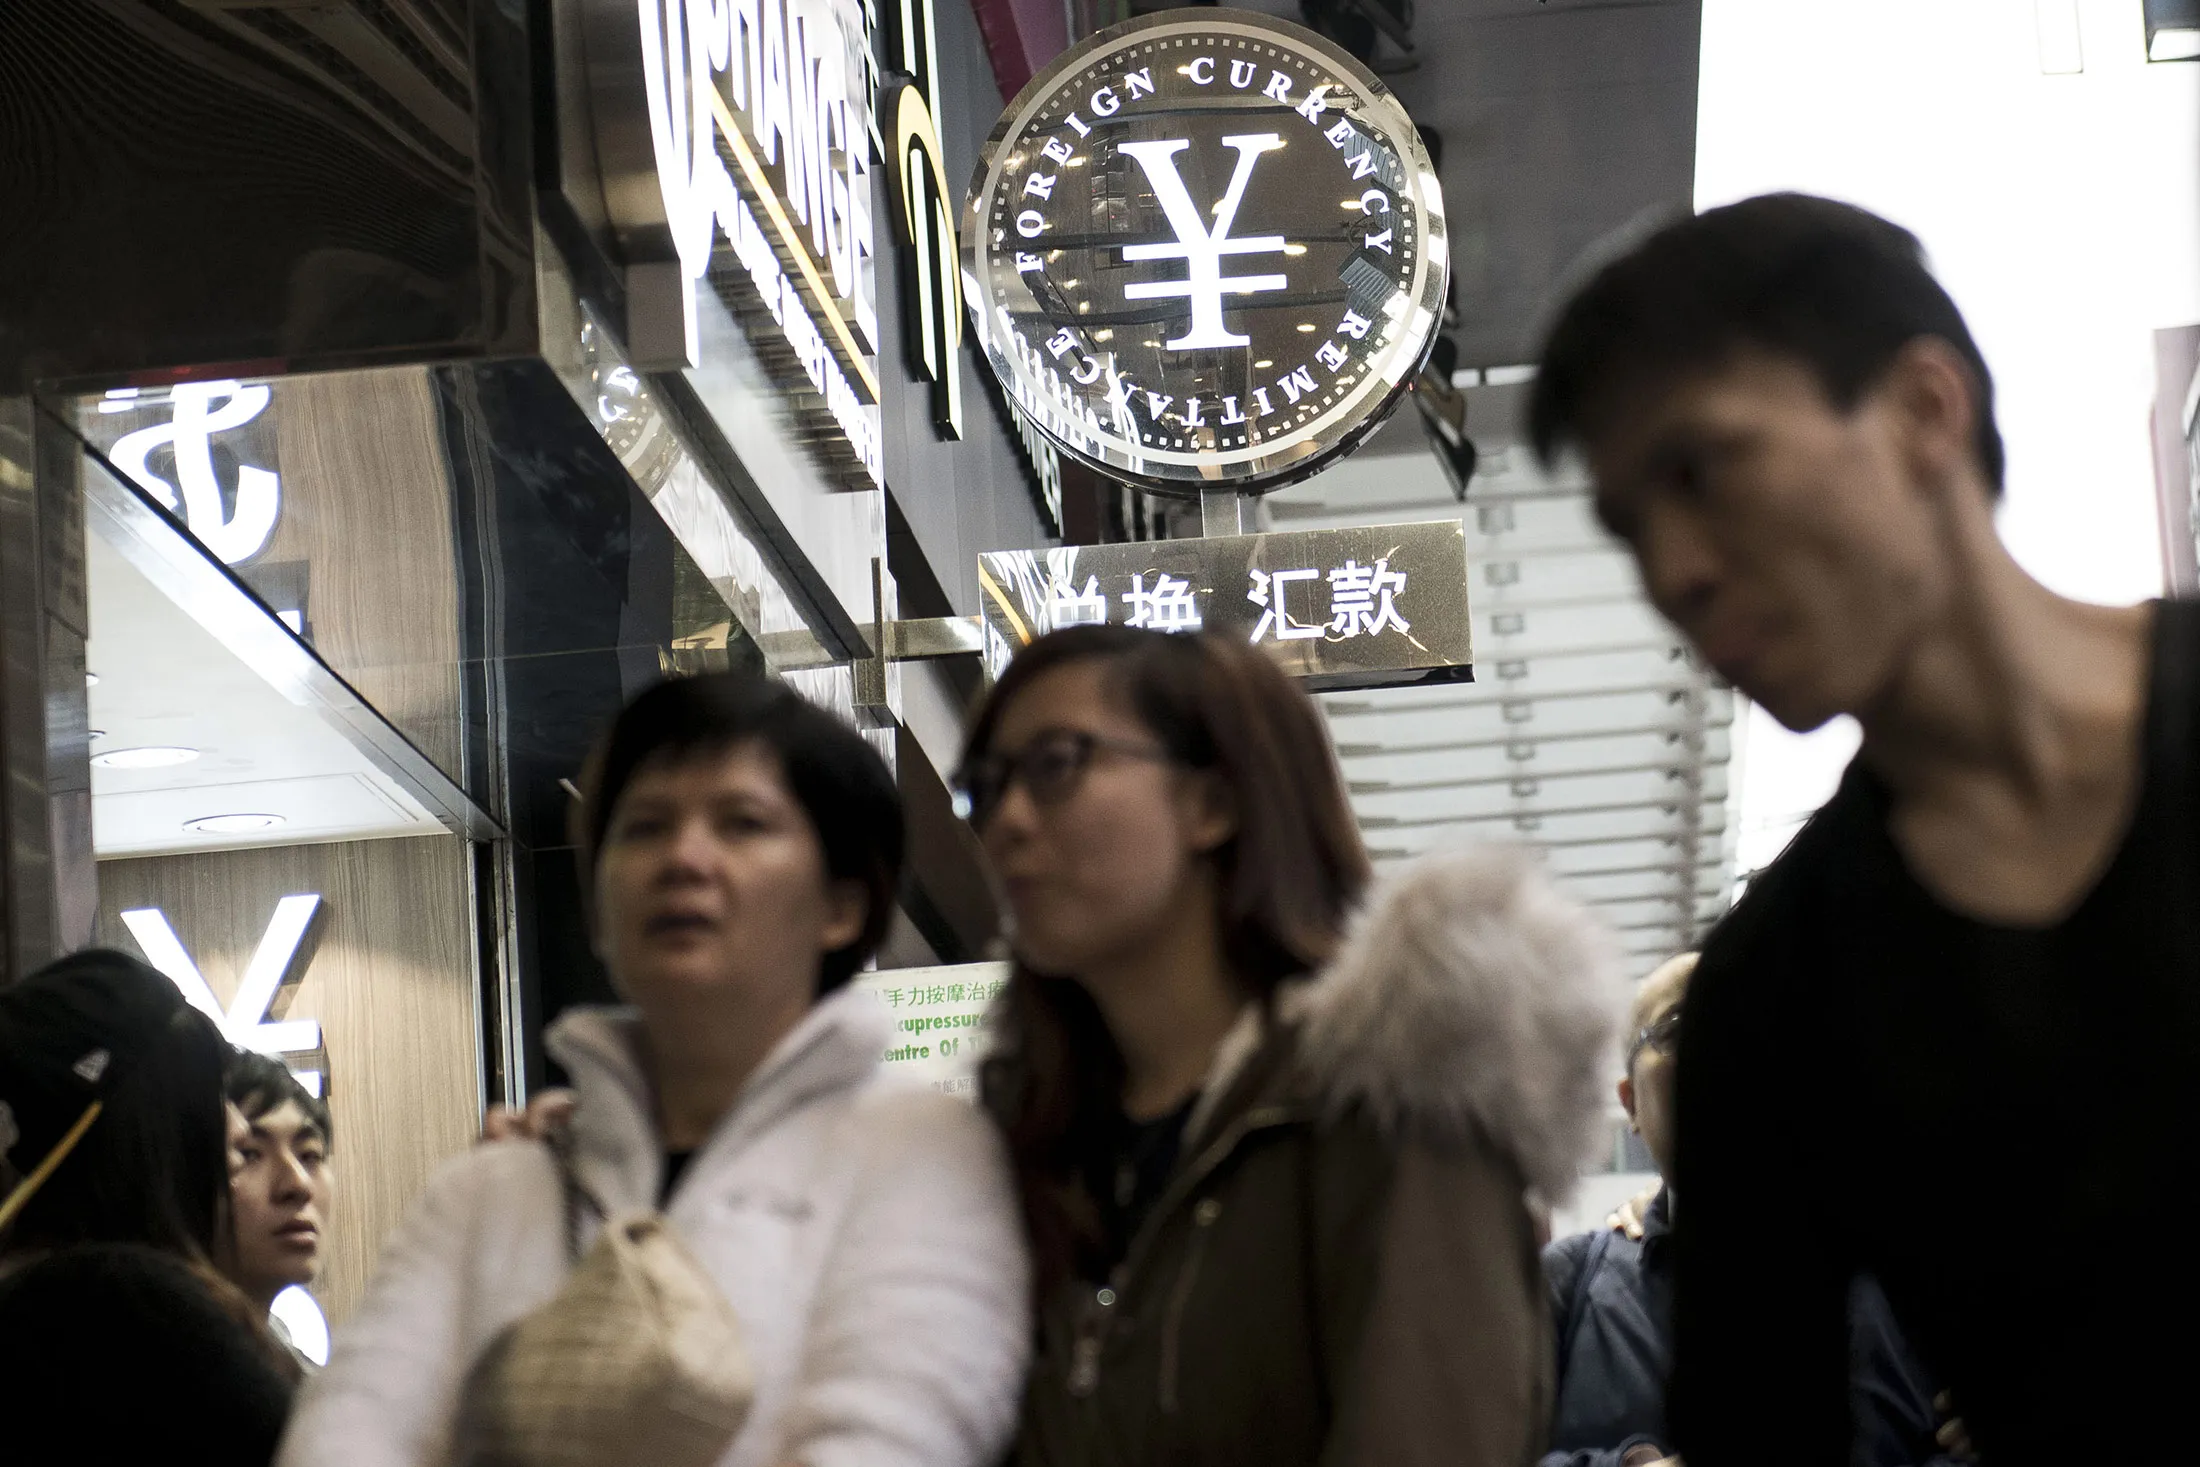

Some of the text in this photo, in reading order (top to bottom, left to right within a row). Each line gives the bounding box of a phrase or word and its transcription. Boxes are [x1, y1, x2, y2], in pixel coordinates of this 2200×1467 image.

[1016, 57, 1392, 427] FOREIGN CURRENCY REMITTANCE
[1117, 133, 1287, 351] ¥
[1247, 560, 1411, 643] 汇款
[873, 980, 1005, 1008] 手力按摩治
[880, 1044, 930, 1062] entre
[939, 1037, 959, 1058] Of
